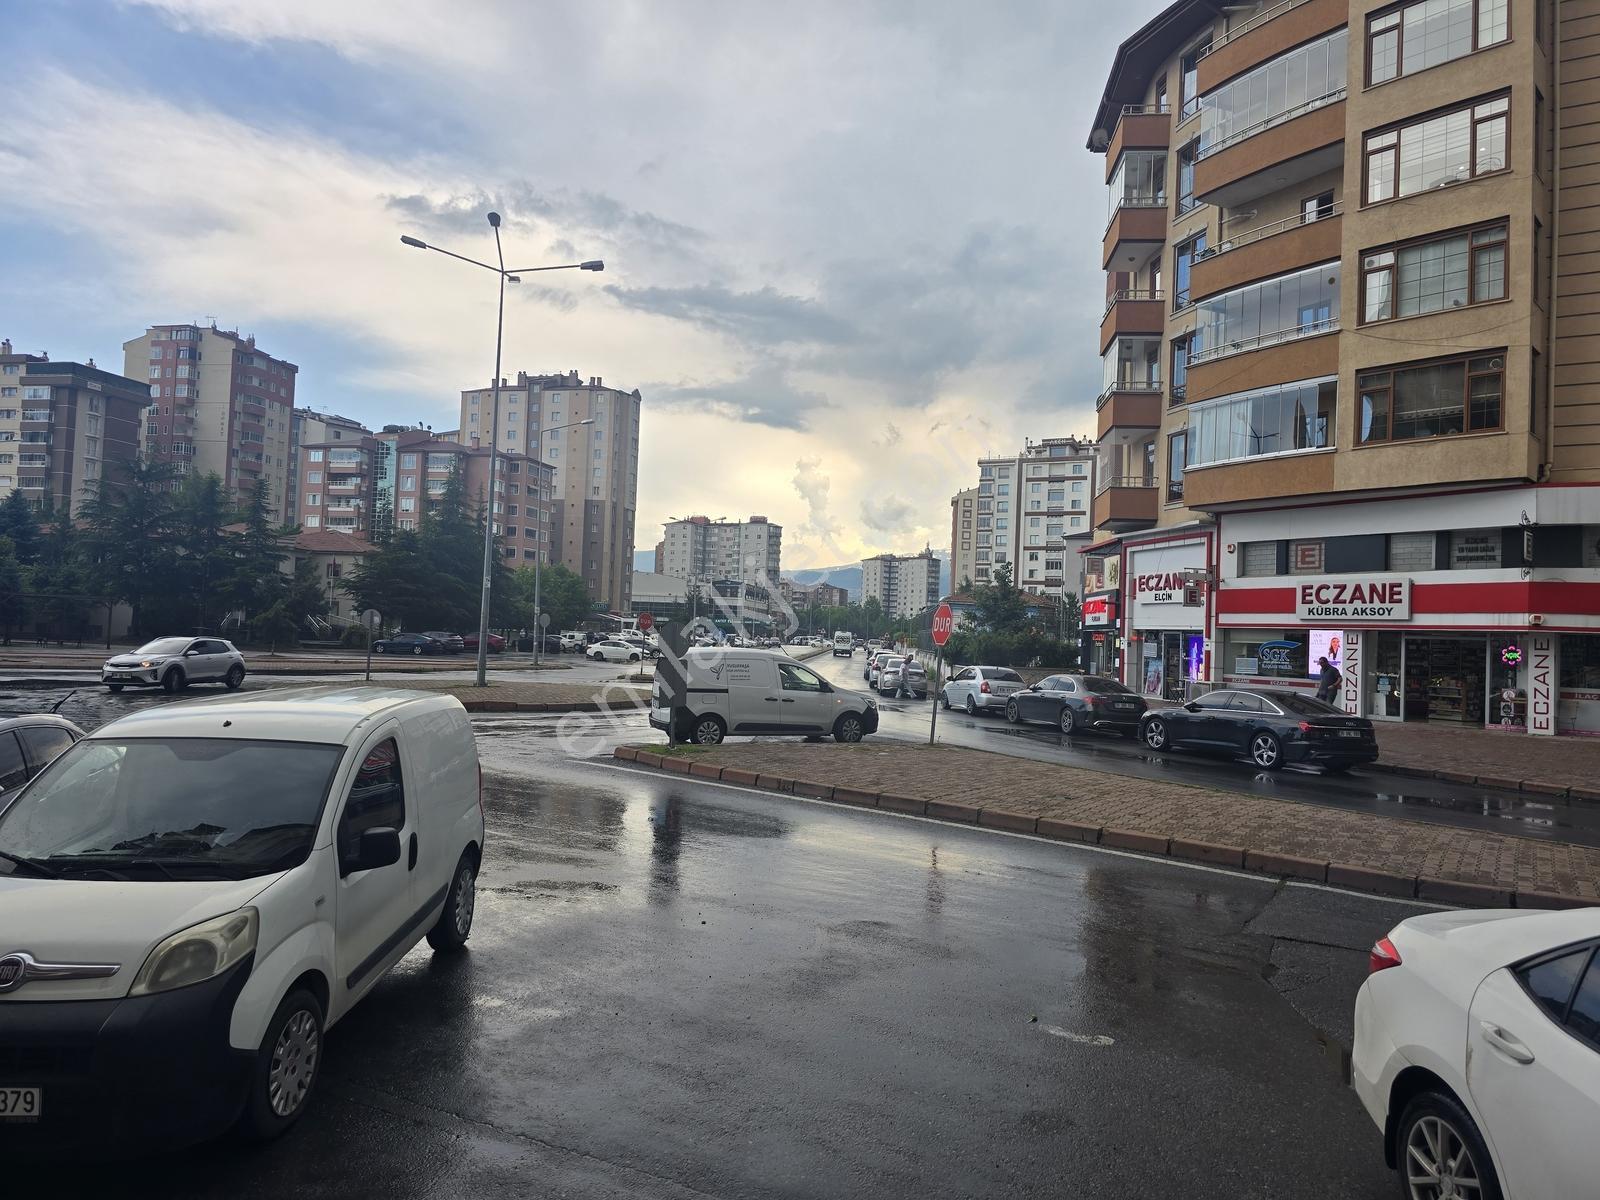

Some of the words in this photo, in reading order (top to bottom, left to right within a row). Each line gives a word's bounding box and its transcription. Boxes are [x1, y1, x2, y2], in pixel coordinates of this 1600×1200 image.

[1301, 548, 1315, 565] E
[1154, 591, 1172, 602] ELÇİN
[1301, 582, 1403, 605] ECZANE
[1307, 605, 1347, 616] KÜBRA
[1351, 607, 1393, 616] AKSOY
[934, 617, 951, 632] DUR
[1262, 648, 1290, 662] SGK
[1345, 633, 1359, 716] ECZANE
[1533, 637, 1550, 730] ECZANE
[0, 1090, 35, 1113] 379
